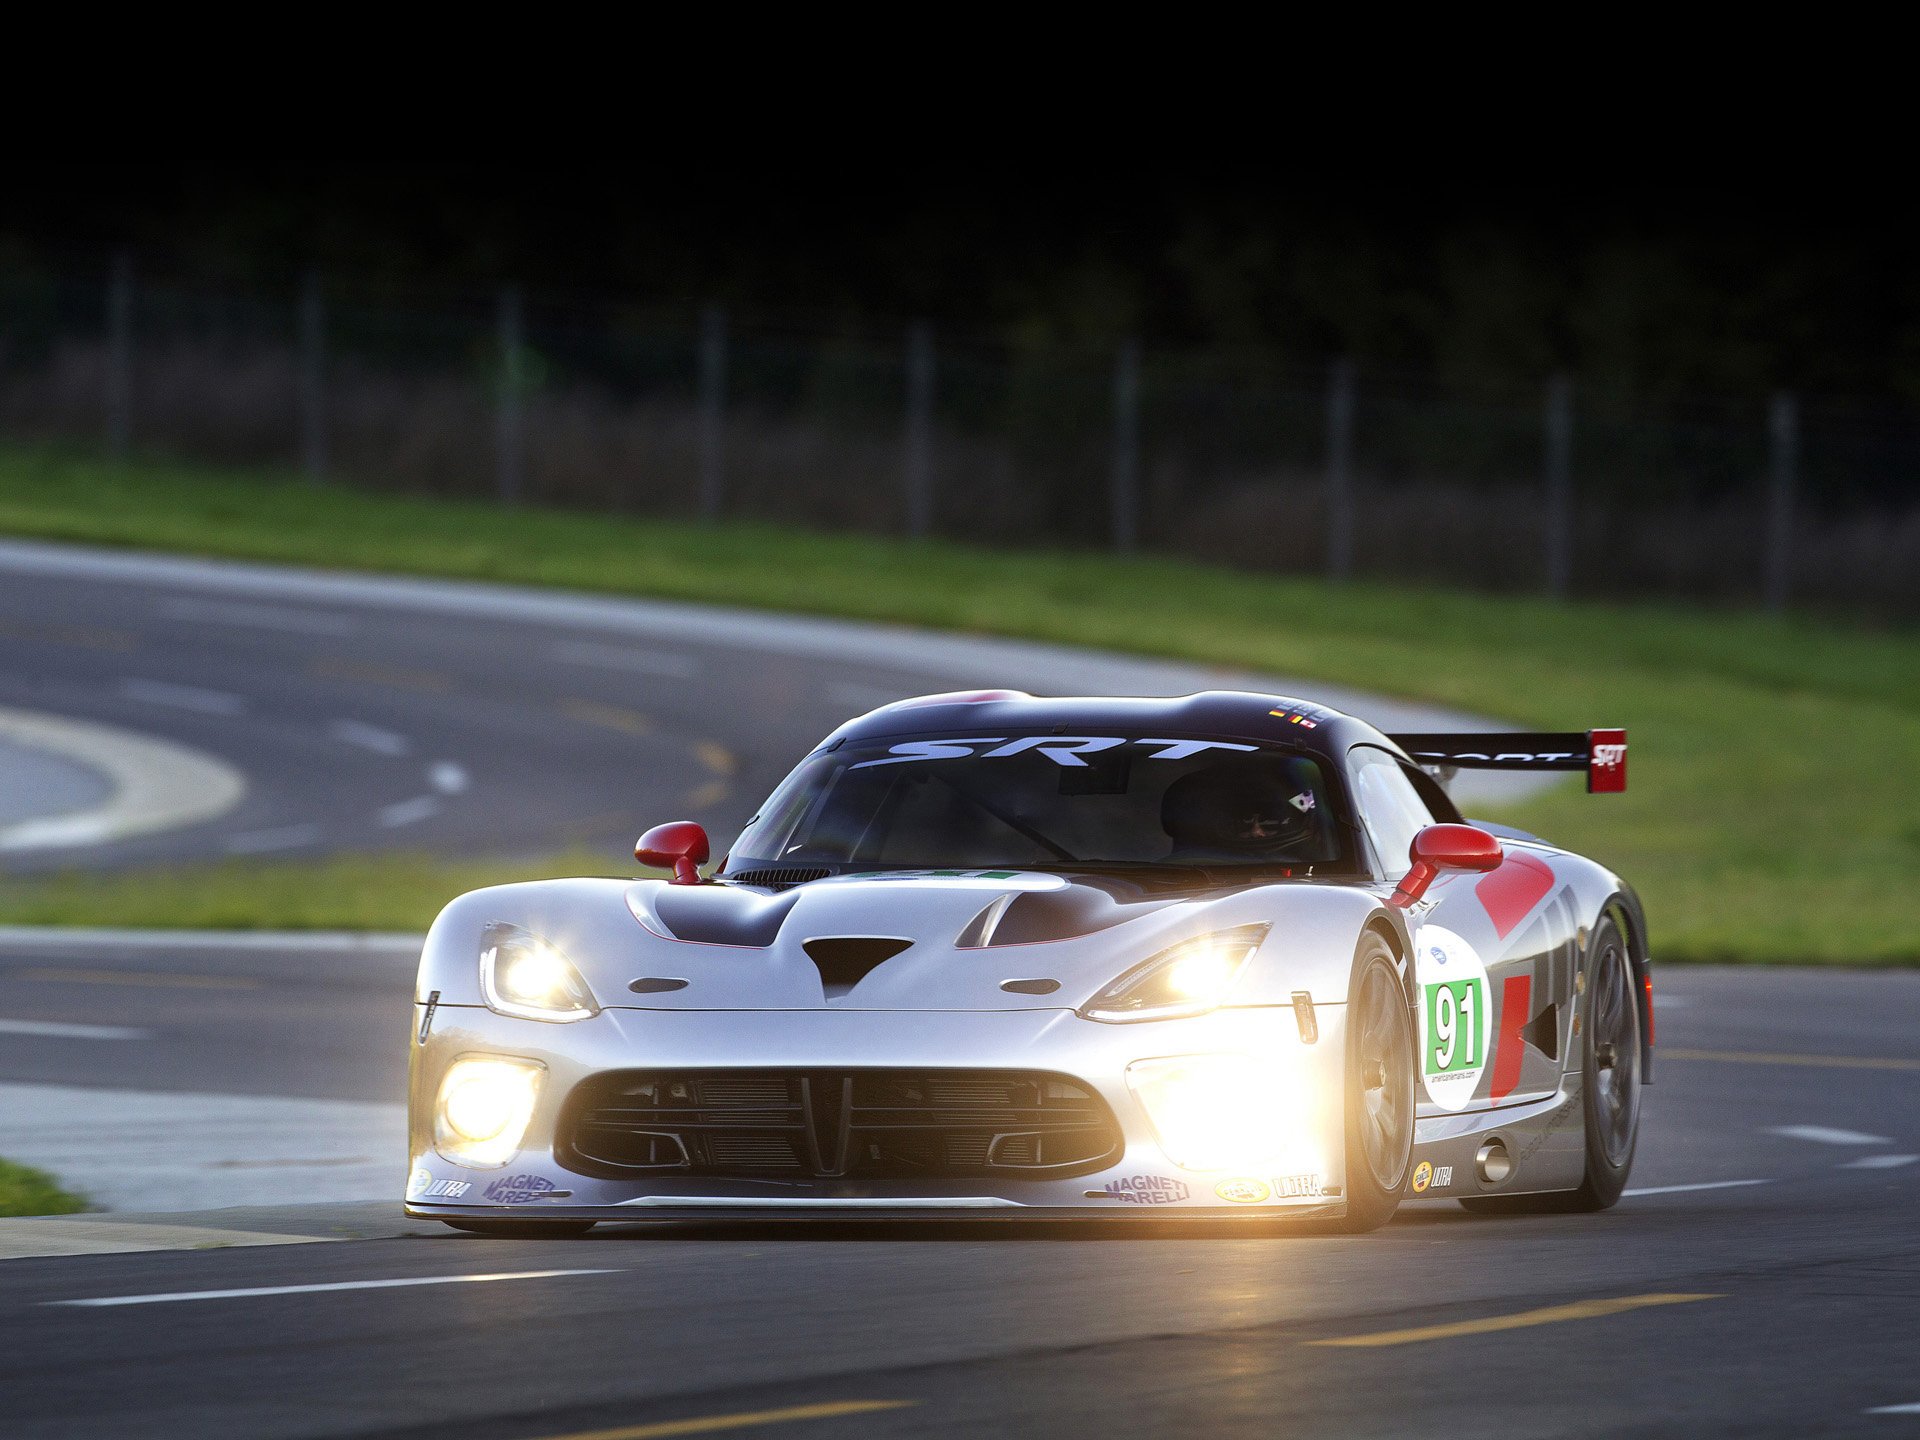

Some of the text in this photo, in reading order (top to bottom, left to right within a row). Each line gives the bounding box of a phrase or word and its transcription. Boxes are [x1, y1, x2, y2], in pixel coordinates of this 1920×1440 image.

[848, 736, 1260, 769] SRT
[1591, 744, 1628, 766] SRT
[1435, 983, 1475, 1070] 91
[481, 1174, 556, 1194] MAGNETI
[1105, 1175, 1189, 1194] MAGNETI
[1272, 1174, 1322, 1198] ULTRA
[1430, 1166, 1453, 1188] ULTRA
[424, 1179, 473, 1198] ULTRA
